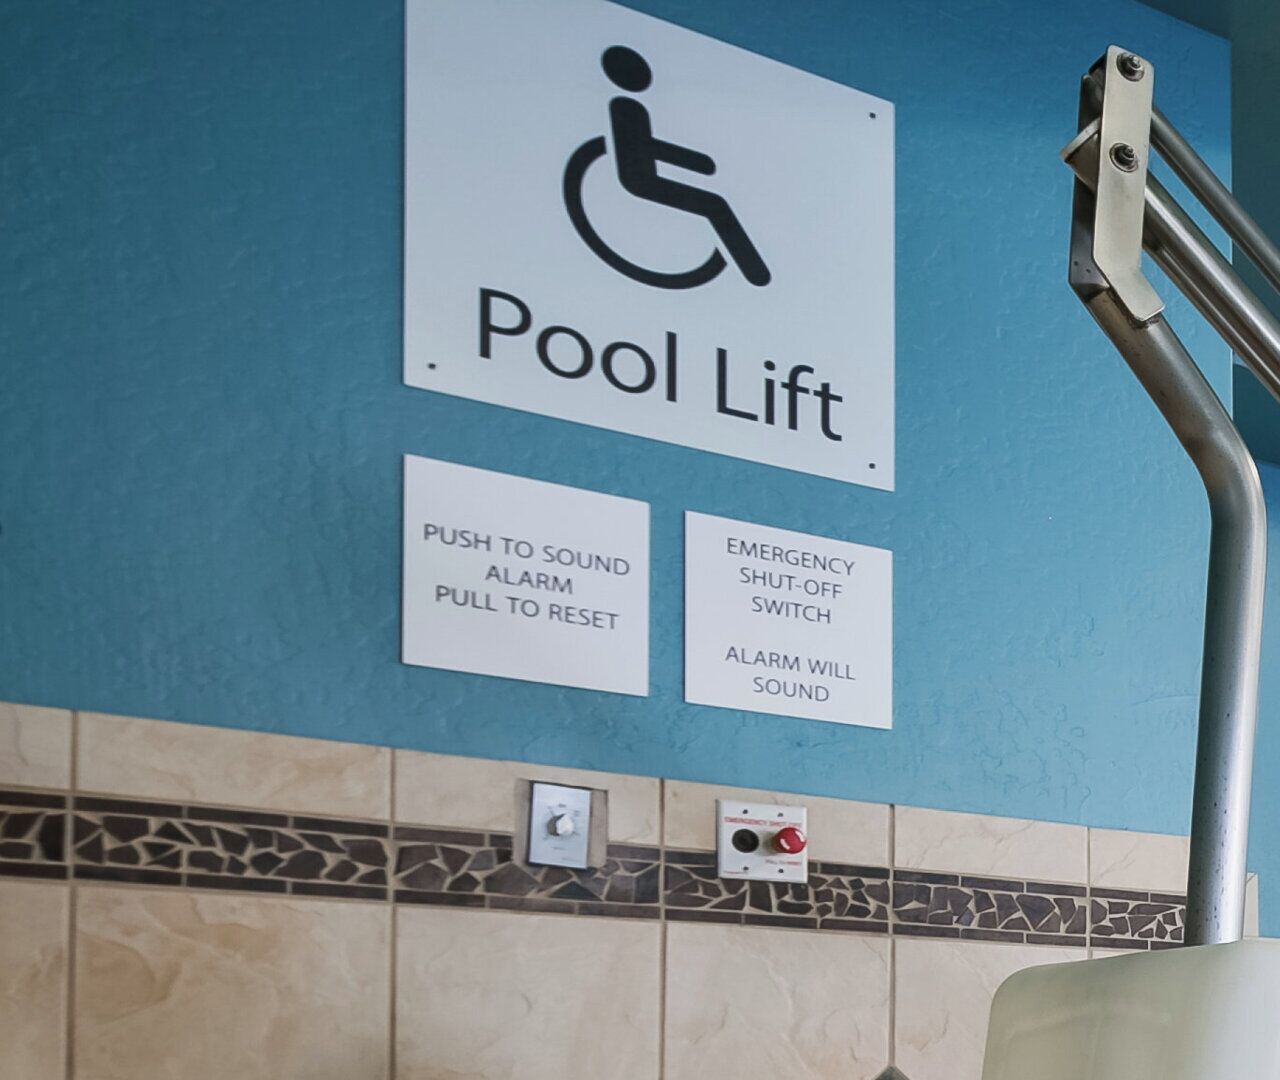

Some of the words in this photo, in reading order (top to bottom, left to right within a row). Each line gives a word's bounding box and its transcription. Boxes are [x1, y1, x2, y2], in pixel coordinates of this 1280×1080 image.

[479, 287, 678, 403] Pool
[716, 347, 844, 442] Lift
[423, 523, 492, 552] PUSH
[500, 537, 534, 559] TO
[542, 545, 630, 576] SOUND
[727, 537, 856, 576] EMERGENCY
[485, 565, 573, 594] ALARM
[740, 566, 843, 599] SHUT-OFF
[435, 584, 498, 612] PULL
[506, 596, 540, 618] TO
[548, 603, 620, 630] RESET
[752, 596, 831, 624] SWITCH
[725, 646, 801, 672] ALARM
[808, 658, 857, 681] WILL
[753, 676, 830, 702] SOUND
